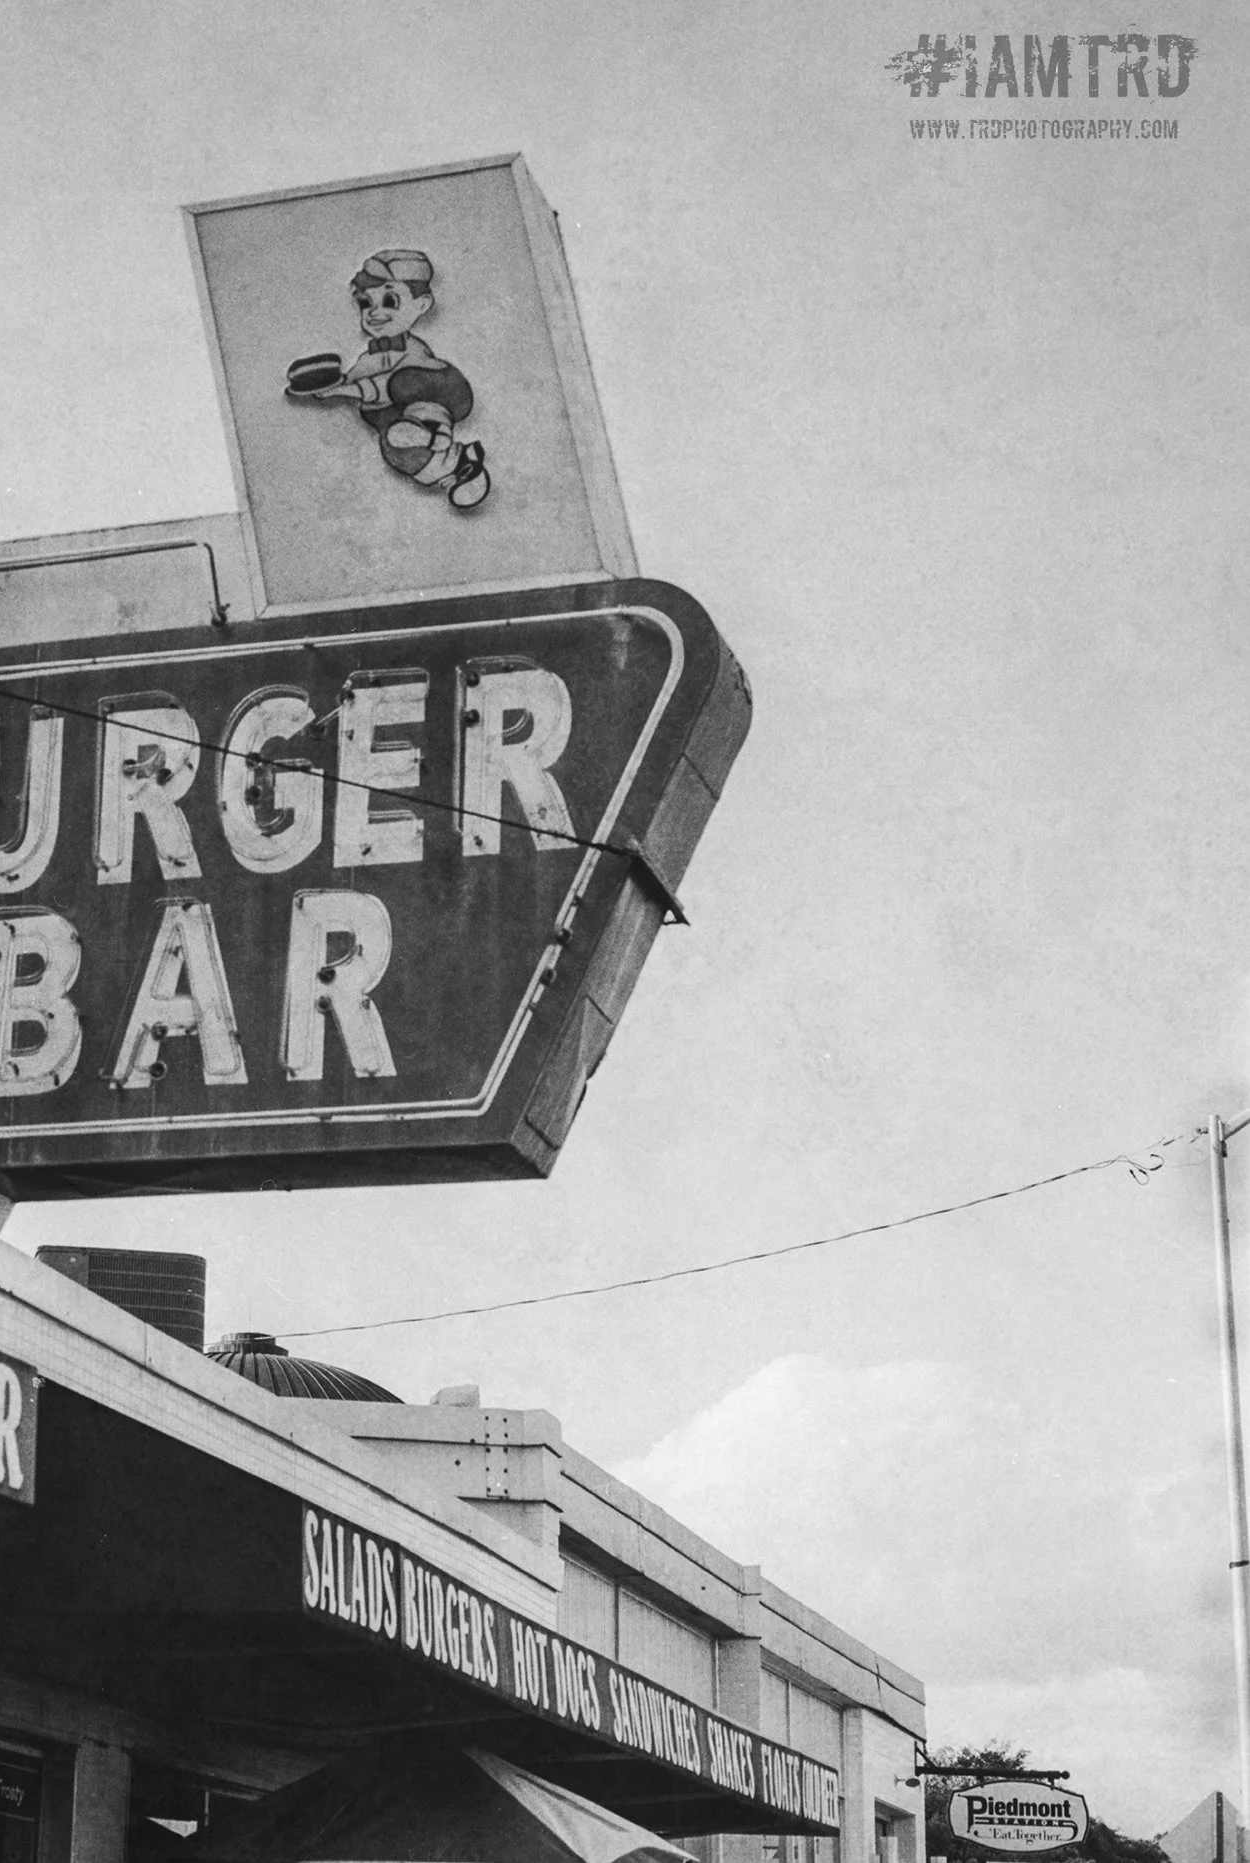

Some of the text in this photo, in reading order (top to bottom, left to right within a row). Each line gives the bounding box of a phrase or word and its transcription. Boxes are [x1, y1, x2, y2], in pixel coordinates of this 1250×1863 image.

[304, 1509, 398, 1640] SALADS
[403, 1558, 499, 1688] BURGERS
[510, 1618, 550, 1710] HOT
[551, 1638, 600, 1731] DOGS
[609, 1667, 701, 1776] SANDWICHES
[707, 1717, 756, 1800] SHAKES
[761, 1743, 801, 1816] FLOATS
[957, 1793, 1071, 1833] Piedmont
